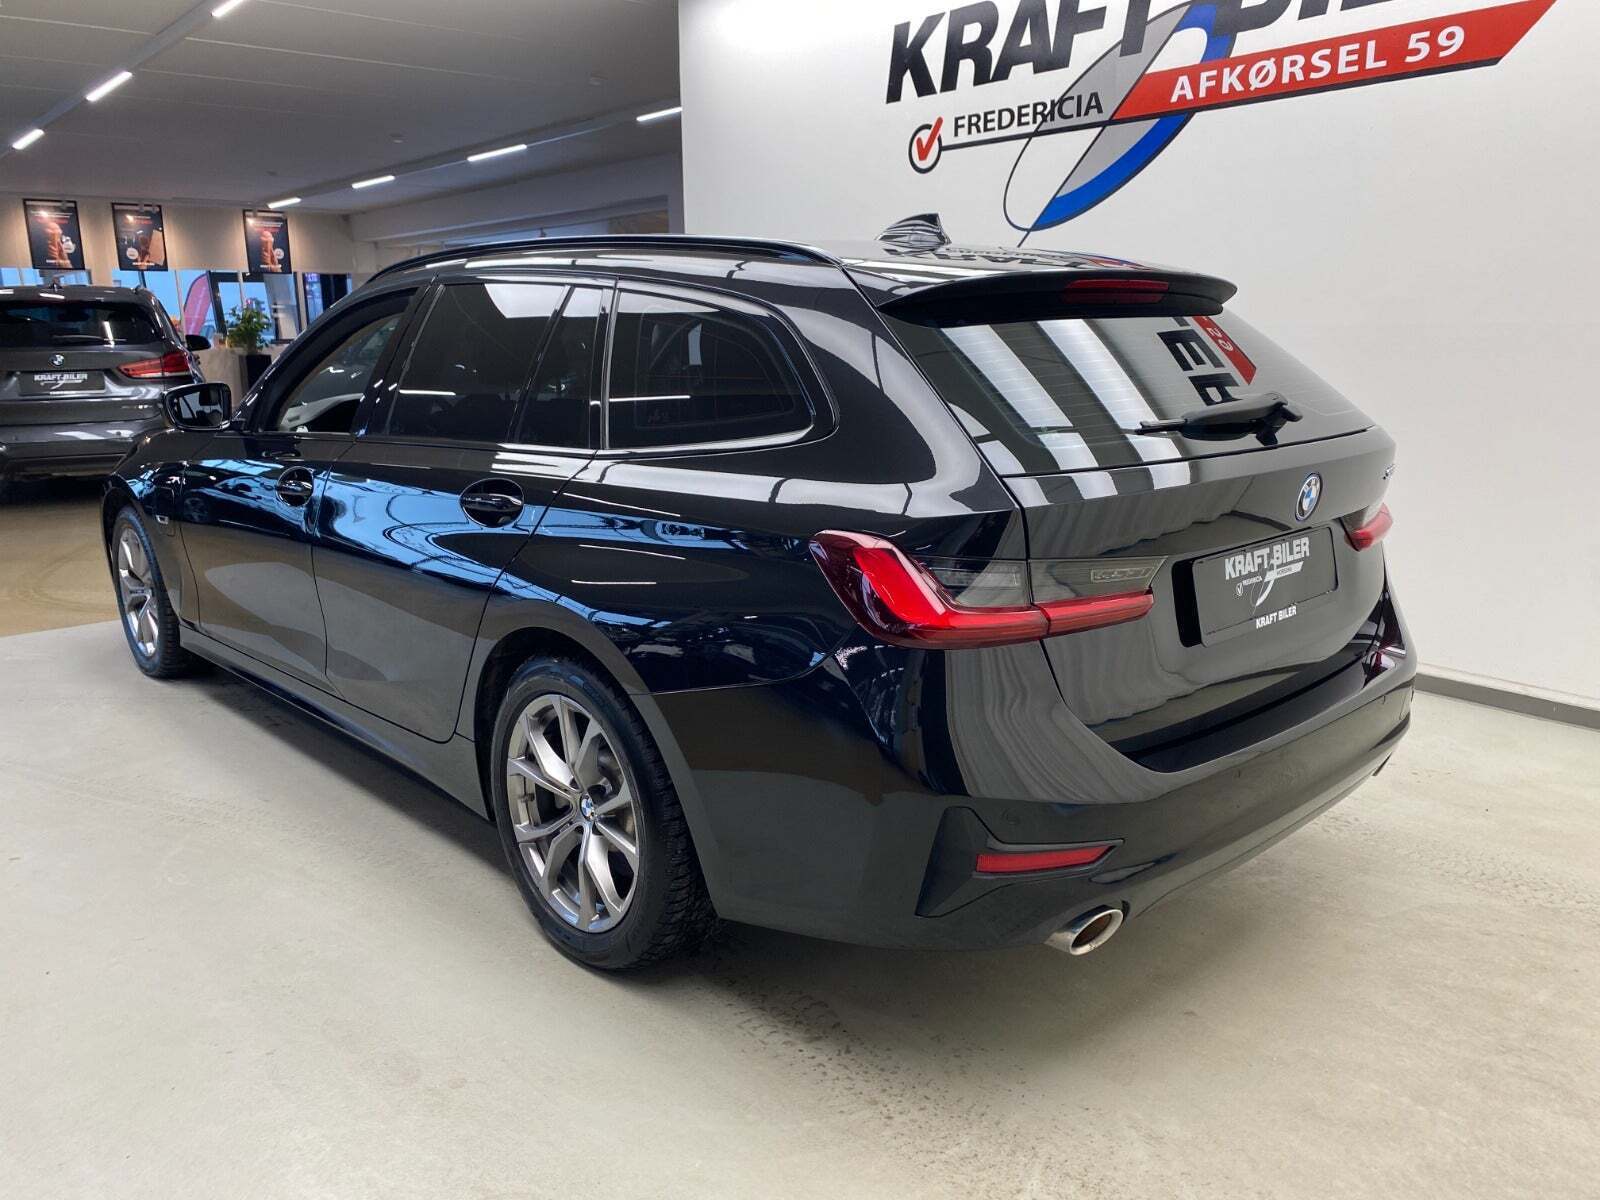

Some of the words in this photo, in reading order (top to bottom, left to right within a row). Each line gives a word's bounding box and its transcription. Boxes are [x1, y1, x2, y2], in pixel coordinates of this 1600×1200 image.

[1170, 39, 1387, 103] AFKØRSEL
[1404, 25, 1465, 63] 59
[953, 91, 1103, 137] FREDERICIA
[1224, 547, 1270, 580] KRAFT
[1272, 536, 1310, 567] BILER
[1255, 612, 1278, 629] KRAFT
[1278, 605, 1297, 621] BILER
